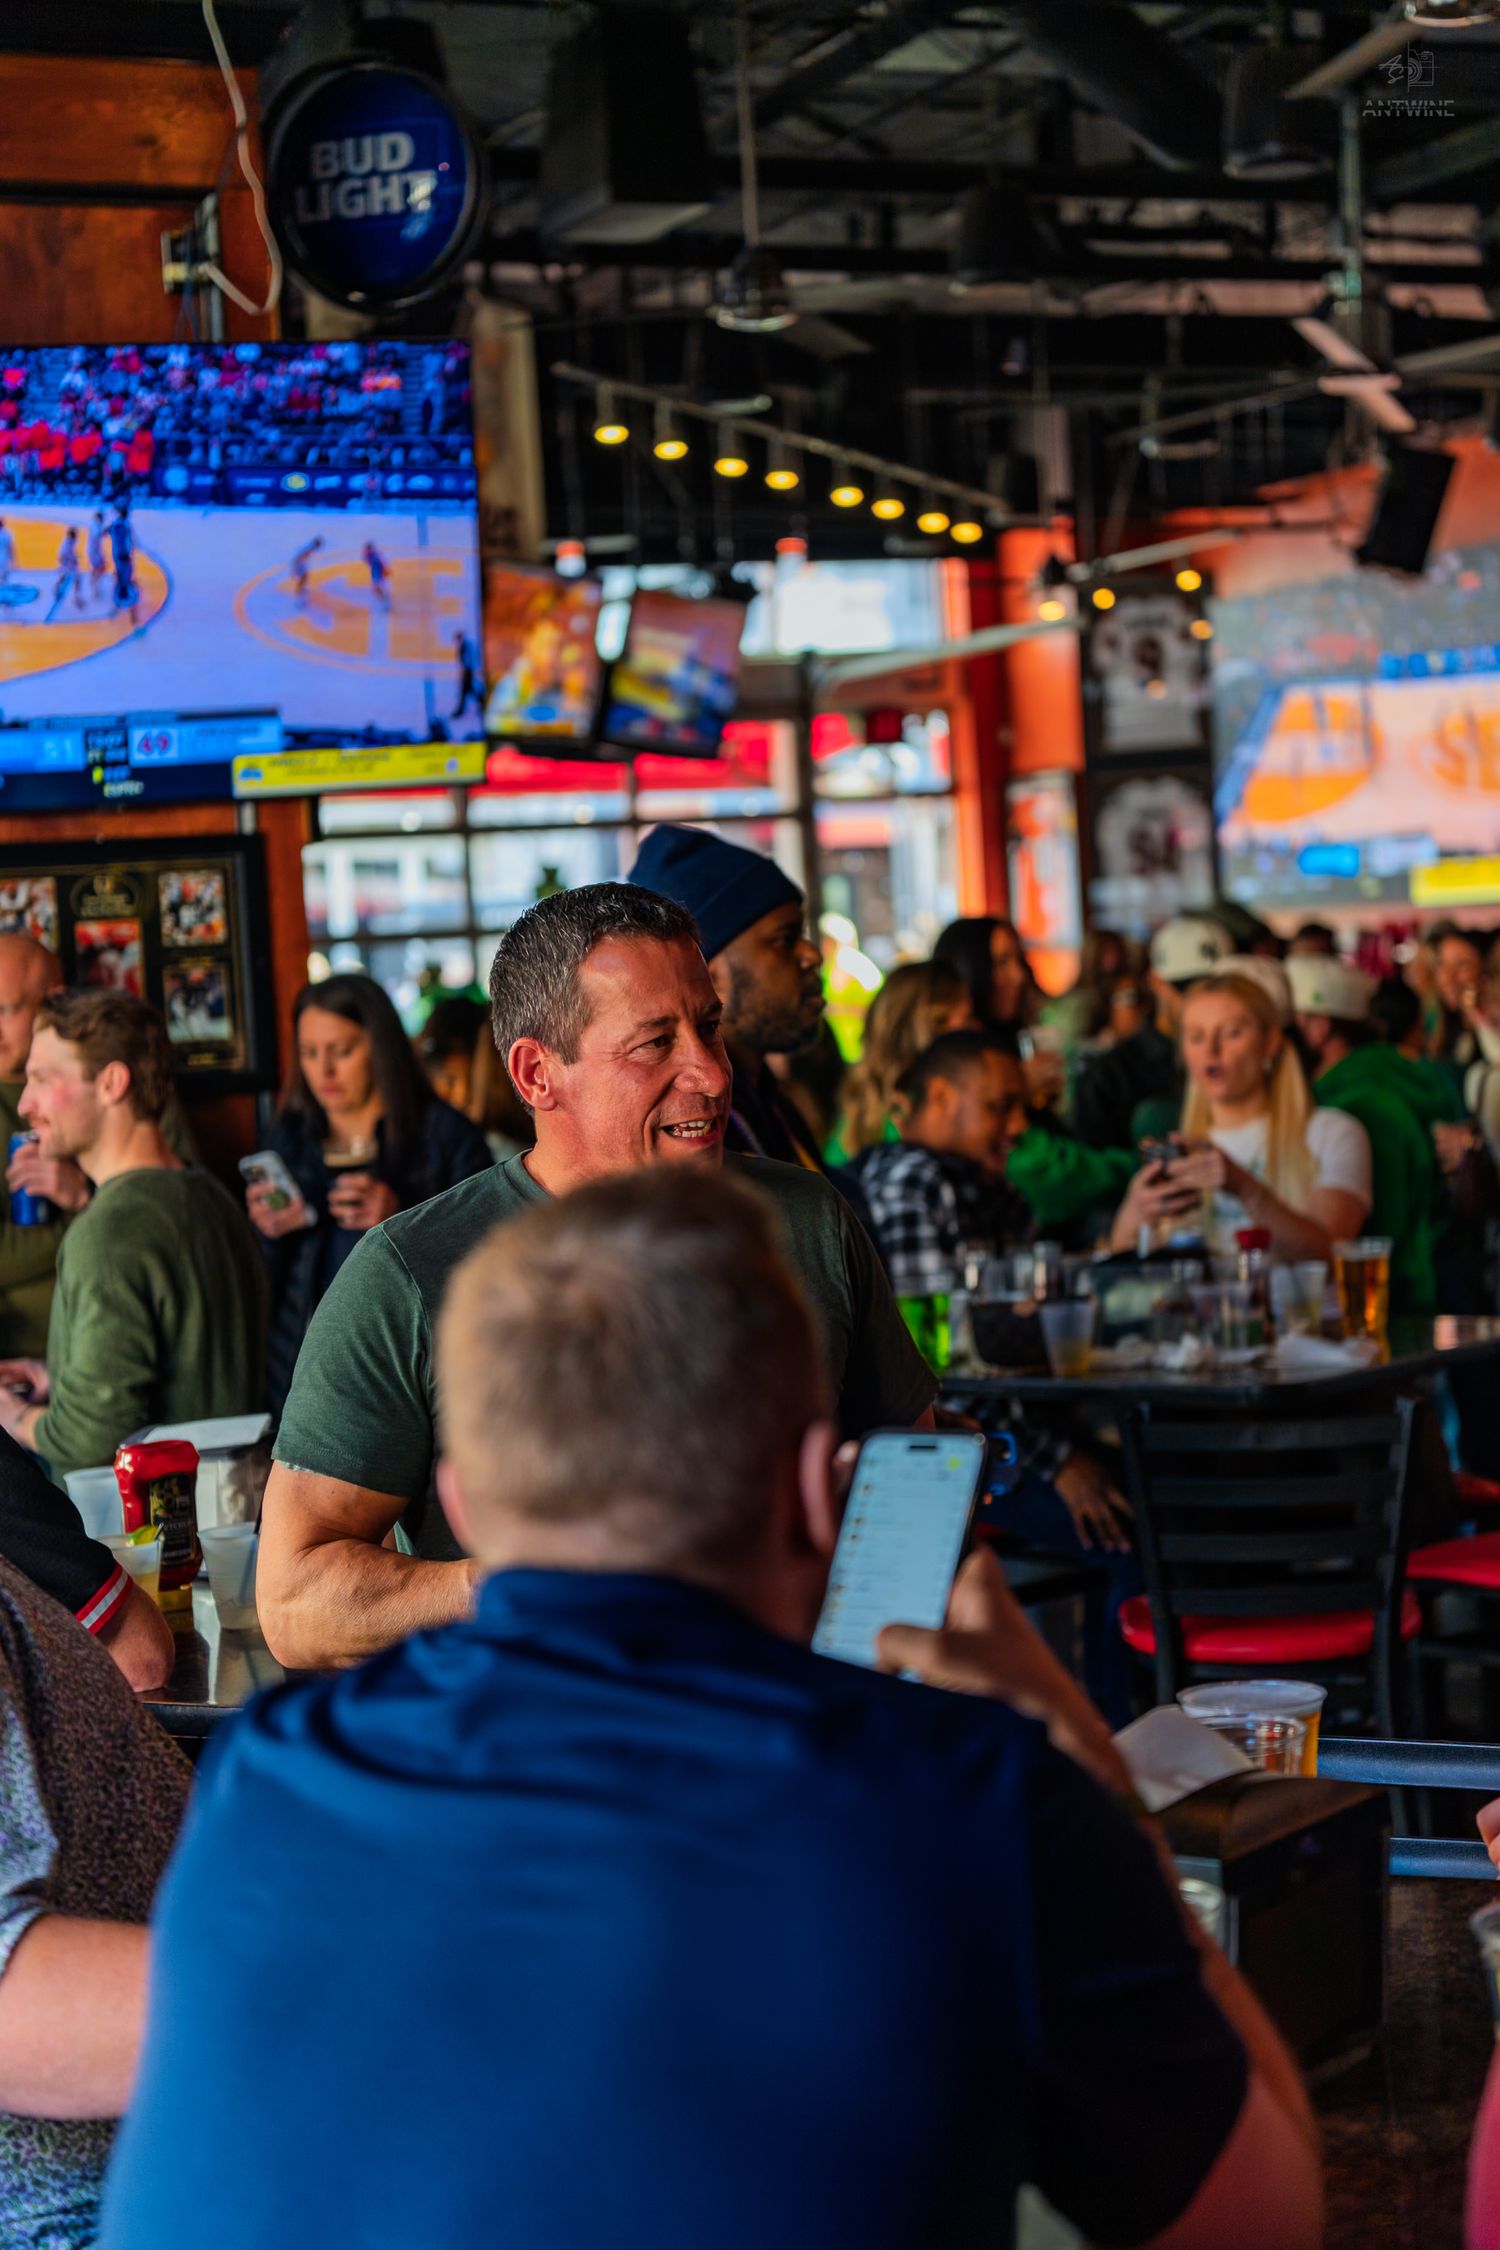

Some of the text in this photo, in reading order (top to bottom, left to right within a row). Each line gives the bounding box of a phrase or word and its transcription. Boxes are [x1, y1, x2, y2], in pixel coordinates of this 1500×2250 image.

[311, 131, 415, 179] BUD
[296, 169, 437, 223] LIGHT
[137, 731, 173, 757] 49
